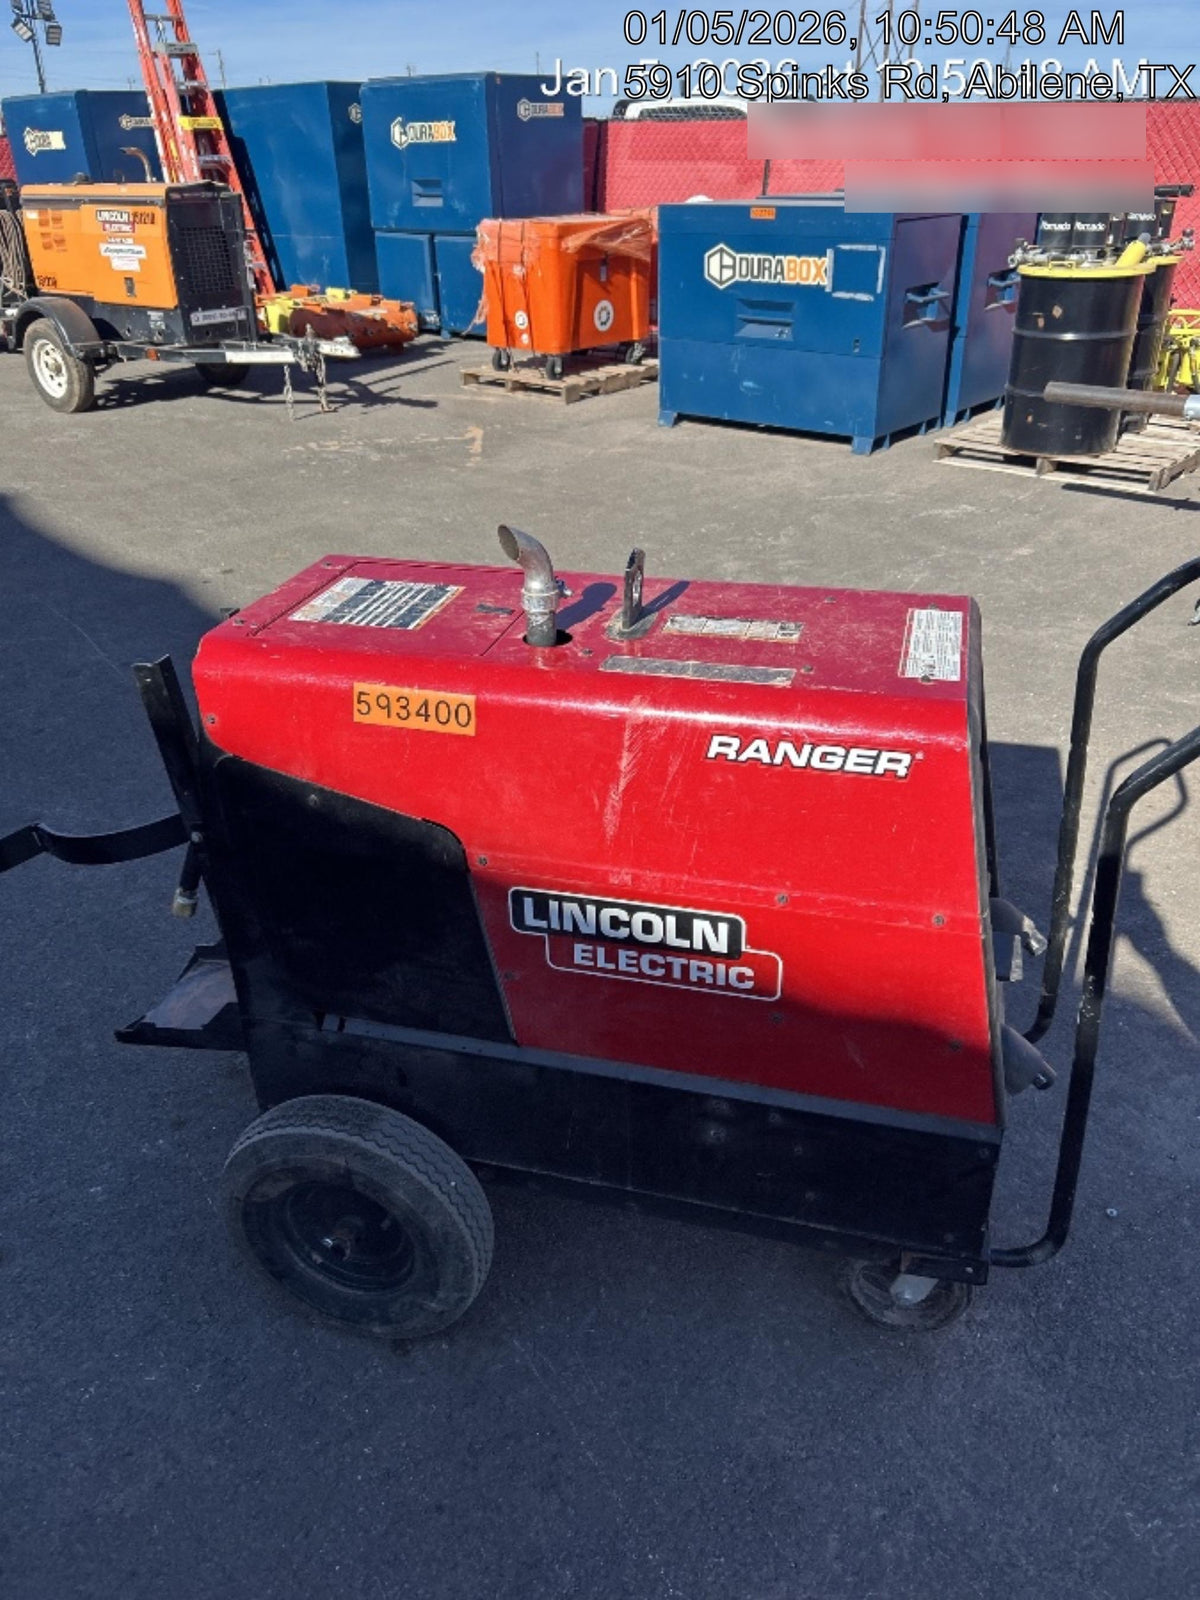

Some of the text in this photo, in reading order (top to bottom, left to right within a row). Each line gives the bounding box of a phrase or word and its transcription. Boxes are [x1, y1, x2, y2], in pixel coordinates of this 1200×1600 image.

[409, 122, 454, 141] DURABOX
[738, 257, 827, 283] DURABOX
[357, 690, 472, 728] 593400
[706, 734, 912, 779] RANGER
[522, 896, 729, 954] LINCOLN
[572, 942, 755, 990] ELECTRIC
